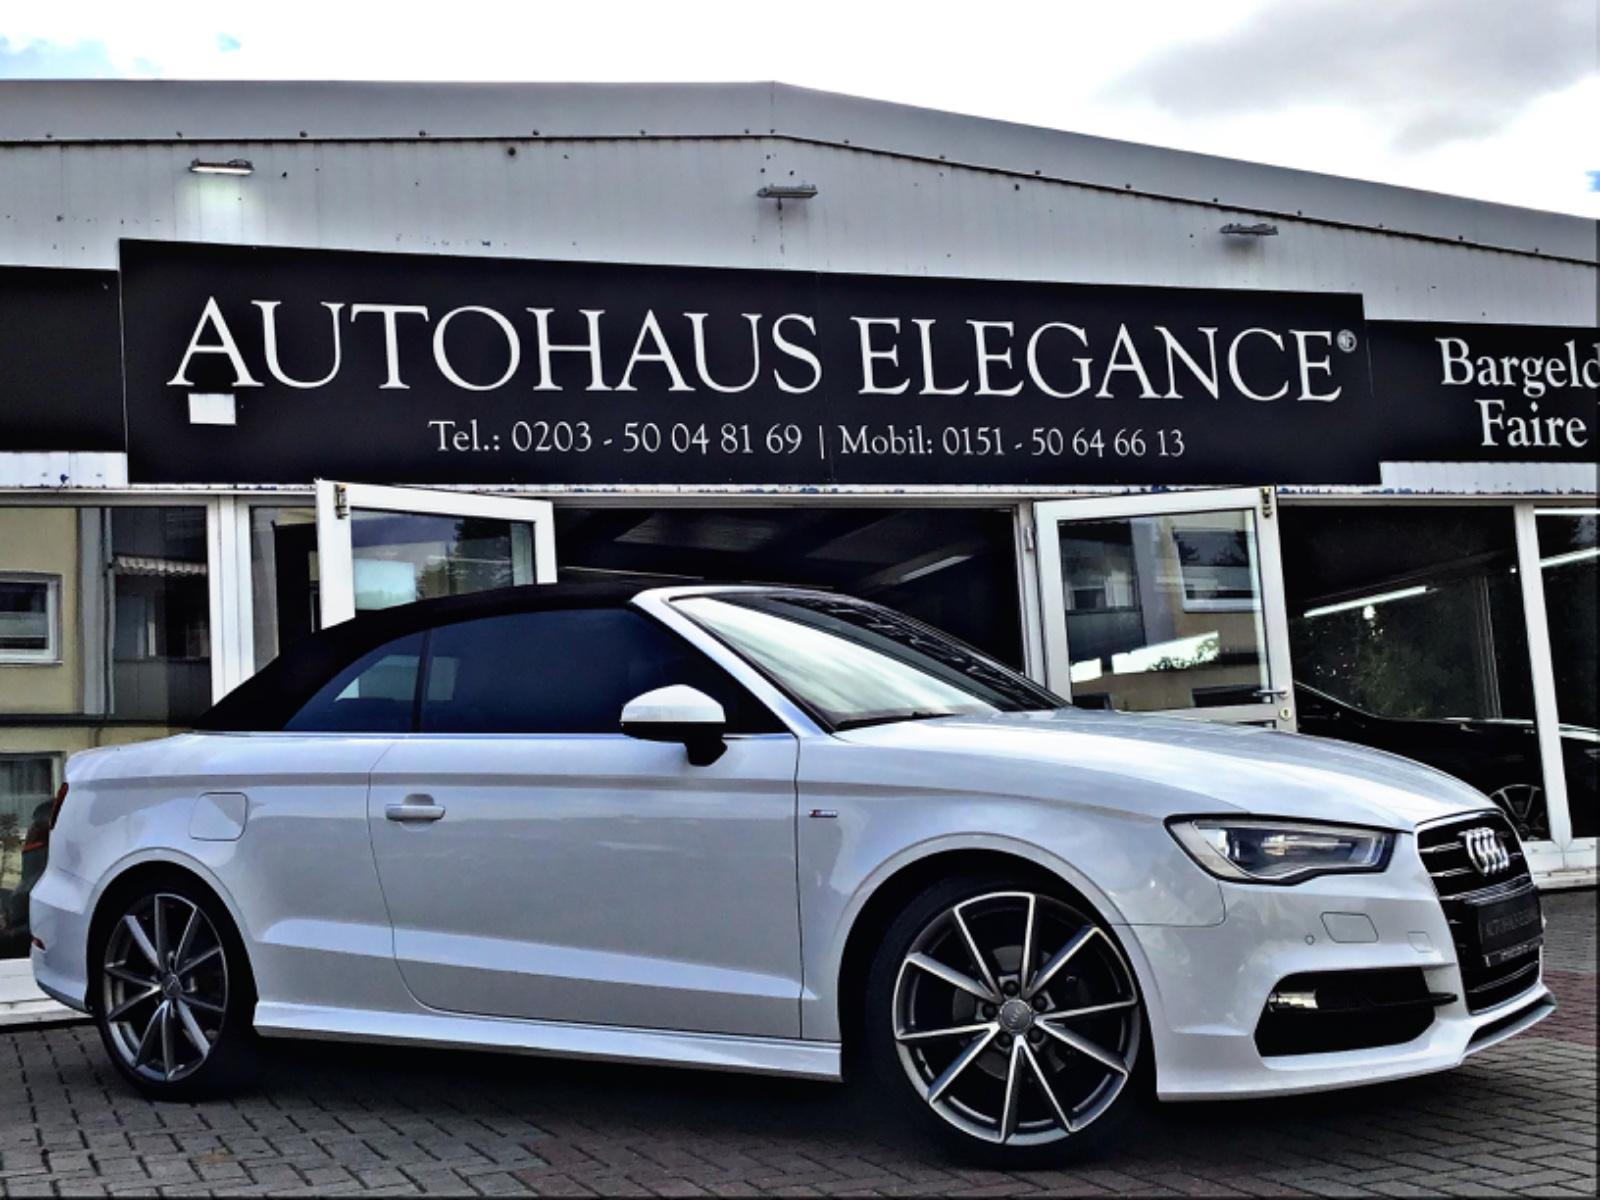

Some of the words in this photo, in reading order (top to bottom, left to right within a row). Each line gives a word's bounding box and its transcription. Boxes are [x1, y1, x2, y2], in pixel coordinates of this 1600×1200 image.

[166, 296, 822, 394] AUTOHAUS
[1435, 337, 1600, 398] Bargeld
[428, 419, 500, 452] Tel.:
[511, 420, 592, 453] 0203
[623, 422, 661, 453] 50
[671, 422, 710, 455] 04
[720, 423, 753, 454] 81
[766, 423, 802, 454] 69
[838, 424, 933, 455] Mobil:
[942, 426, 1003, 455] 0151
[1032, 427, 1064, 456] 50
[1072, 428, 1105, 458] 64
[1114, 428, 1146, 456] 66
[1157, 429, 1185, 457] 13
[1474, 399, 1588, 448] Faire
